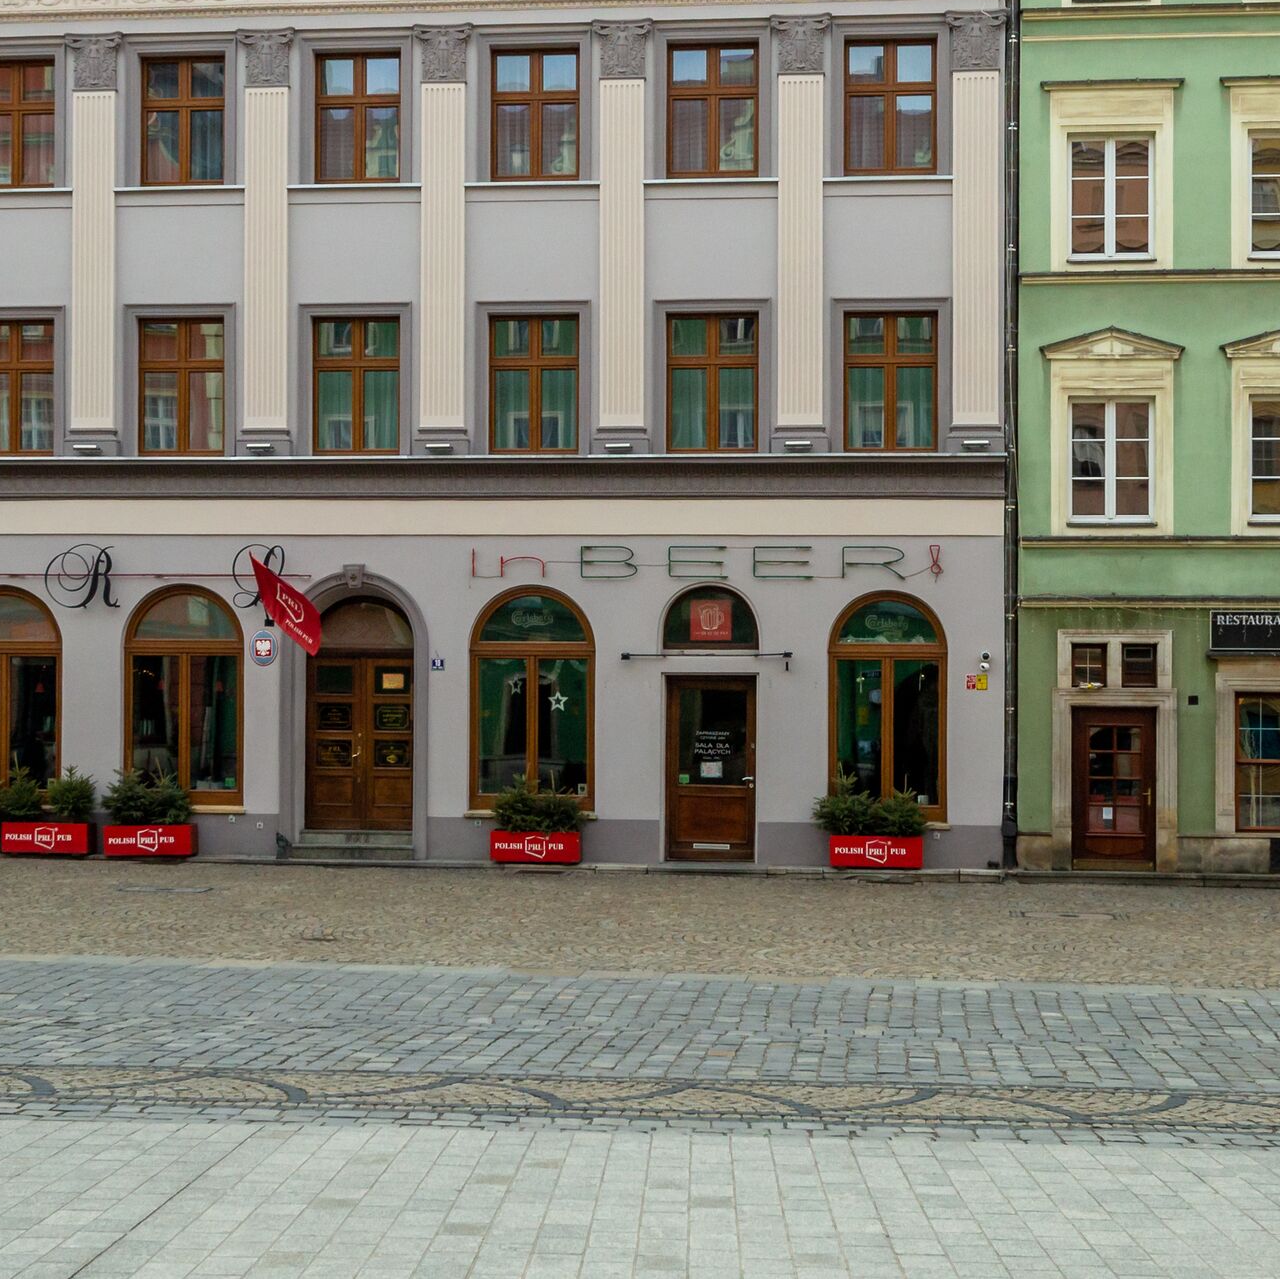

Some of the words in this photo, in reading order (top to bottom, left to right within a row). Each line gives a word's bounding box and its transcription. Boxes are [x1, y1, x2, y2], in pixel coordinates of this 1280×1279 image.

[5, 833, 32, 841] POLISH
[108, 837, 136, 845] POLISH
[494, 842, 523, 850] POLISH
[834, 847, 864, 855] POLISH
[890, 847, 907, 855] PUB
